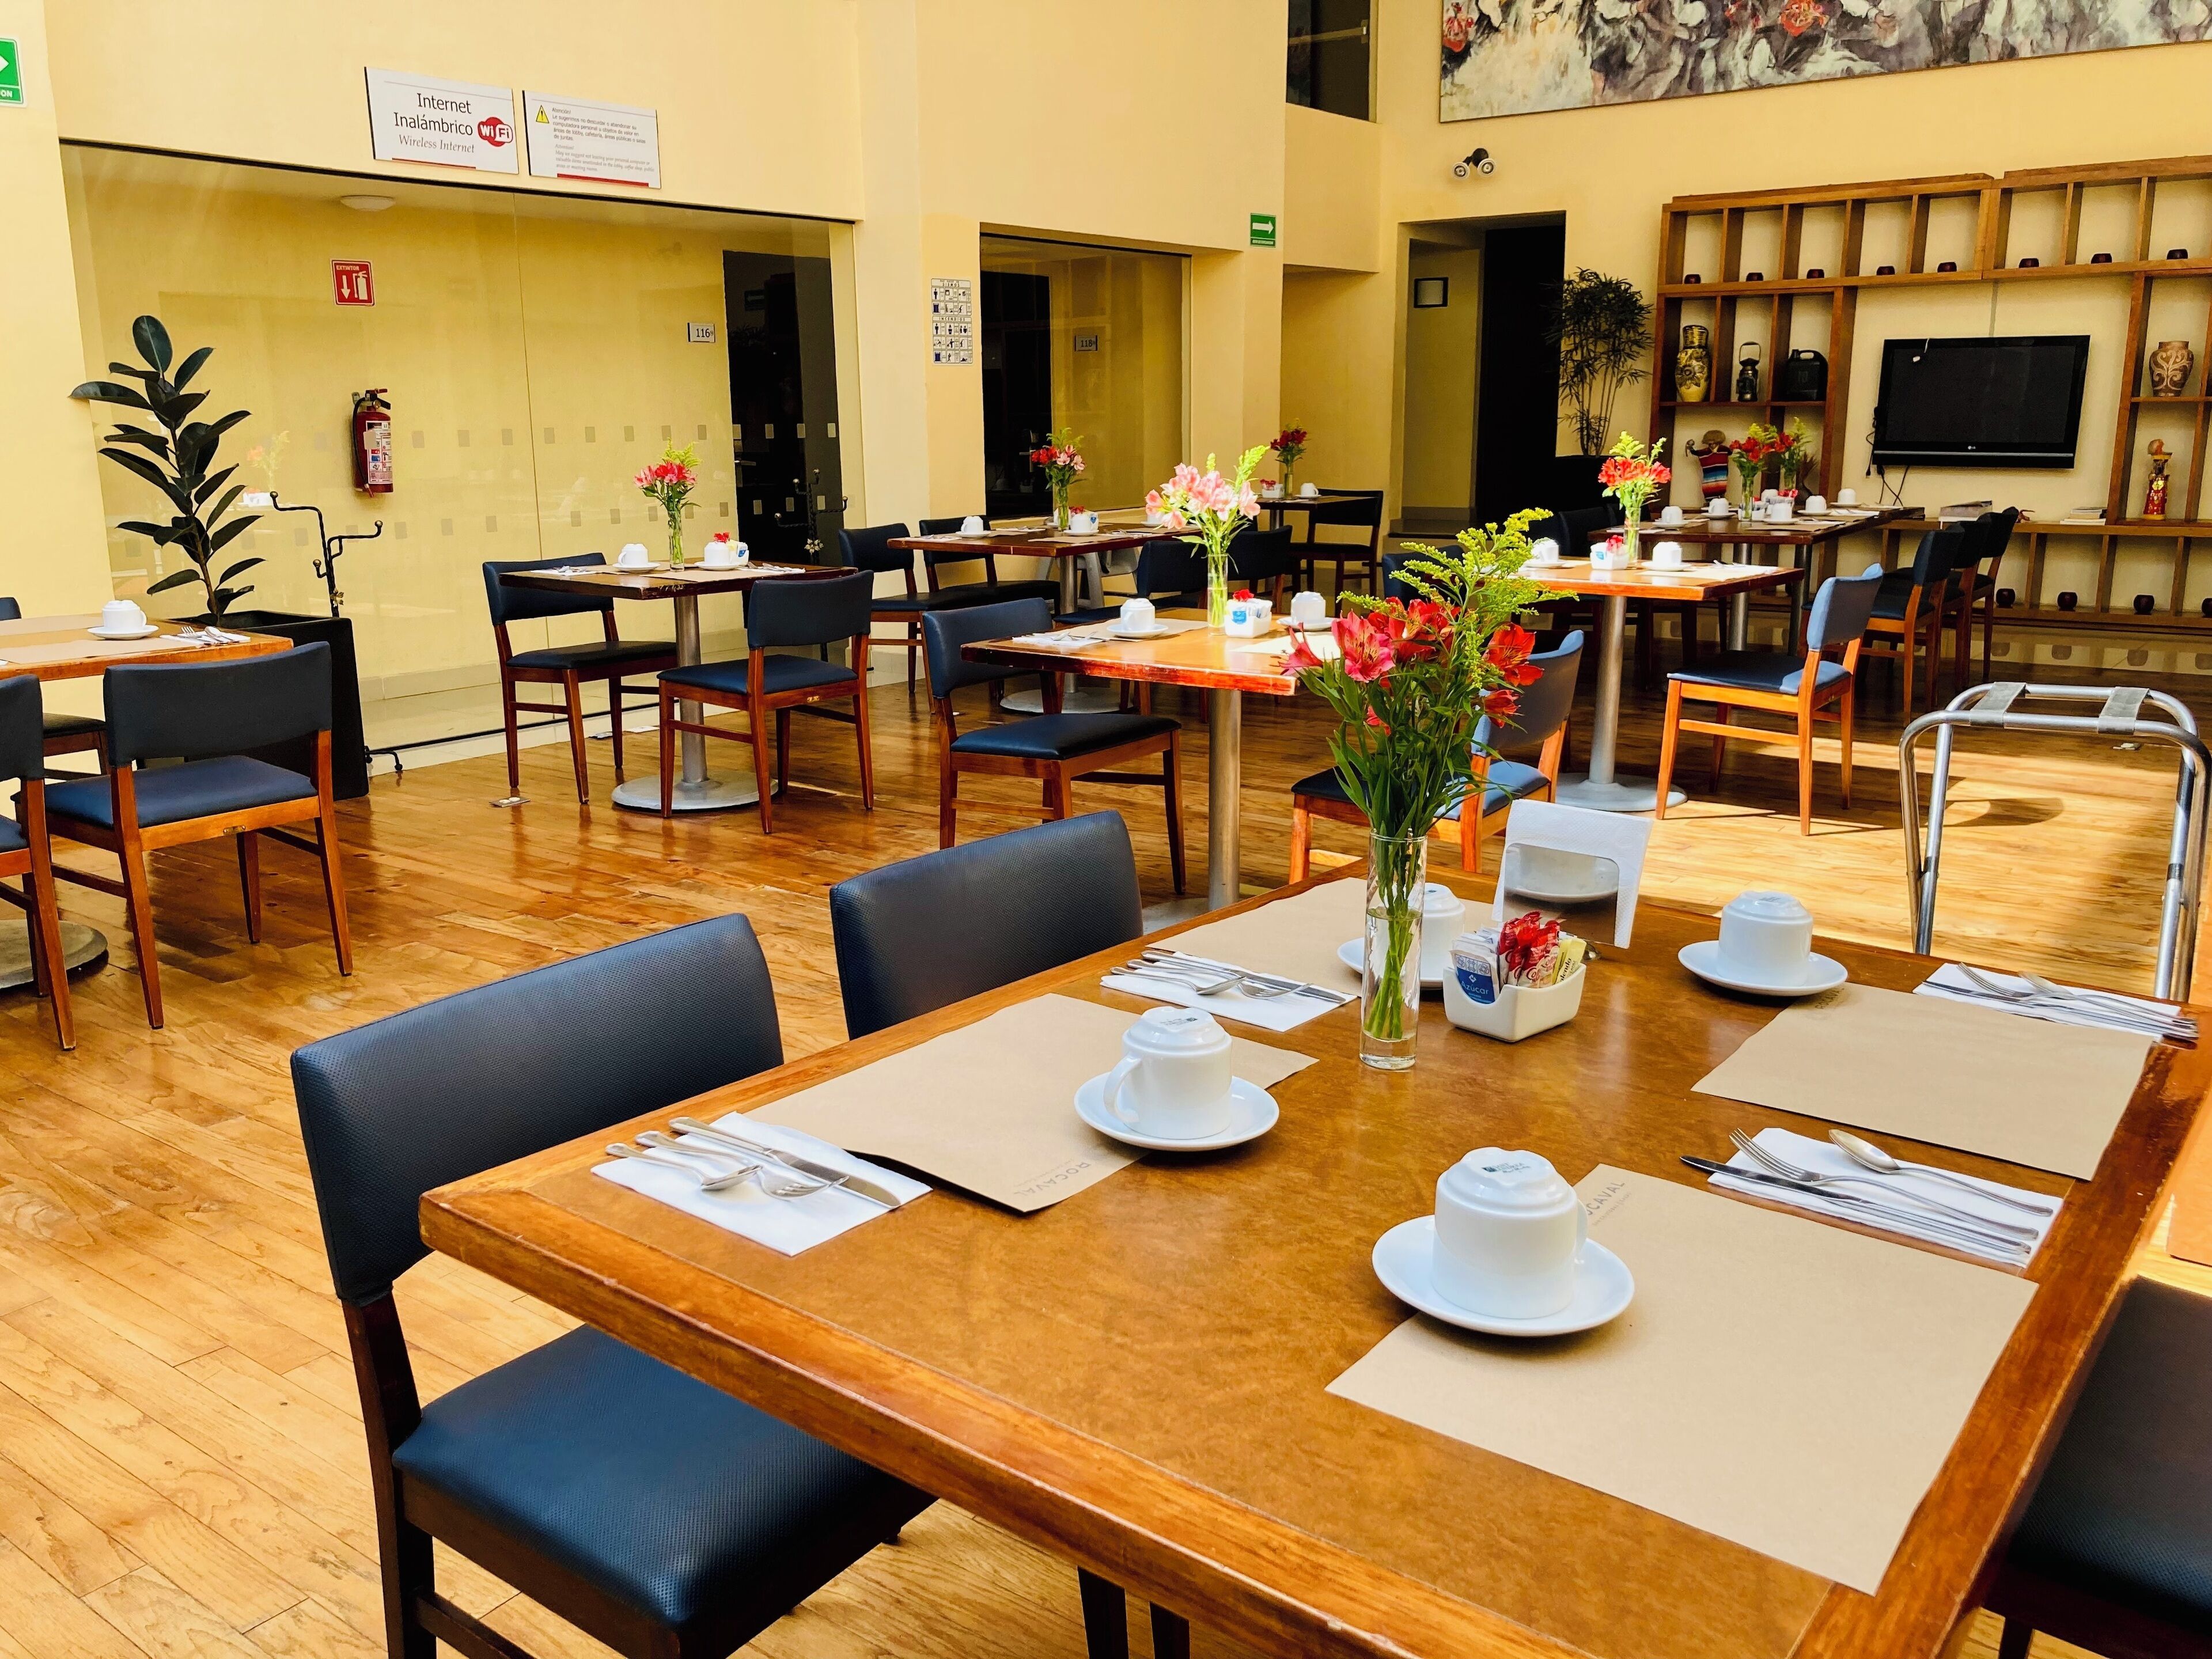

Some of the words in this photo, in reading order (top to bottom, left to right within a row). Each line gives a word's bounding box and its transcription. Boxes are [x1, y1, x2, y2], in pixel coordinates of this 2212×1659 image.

[417, 93, 472, 114] Internet
[393, 112, 473, 135] Inalámbrico
[399, 134, 437, 149] Wireless
[440, 139, 474, 153] Internet
[696, 328, 710, 338] 116
[1461, 980, 1489, 994] Azúcar
[1014, 1162, 1092, 1196] ROCAVAL
